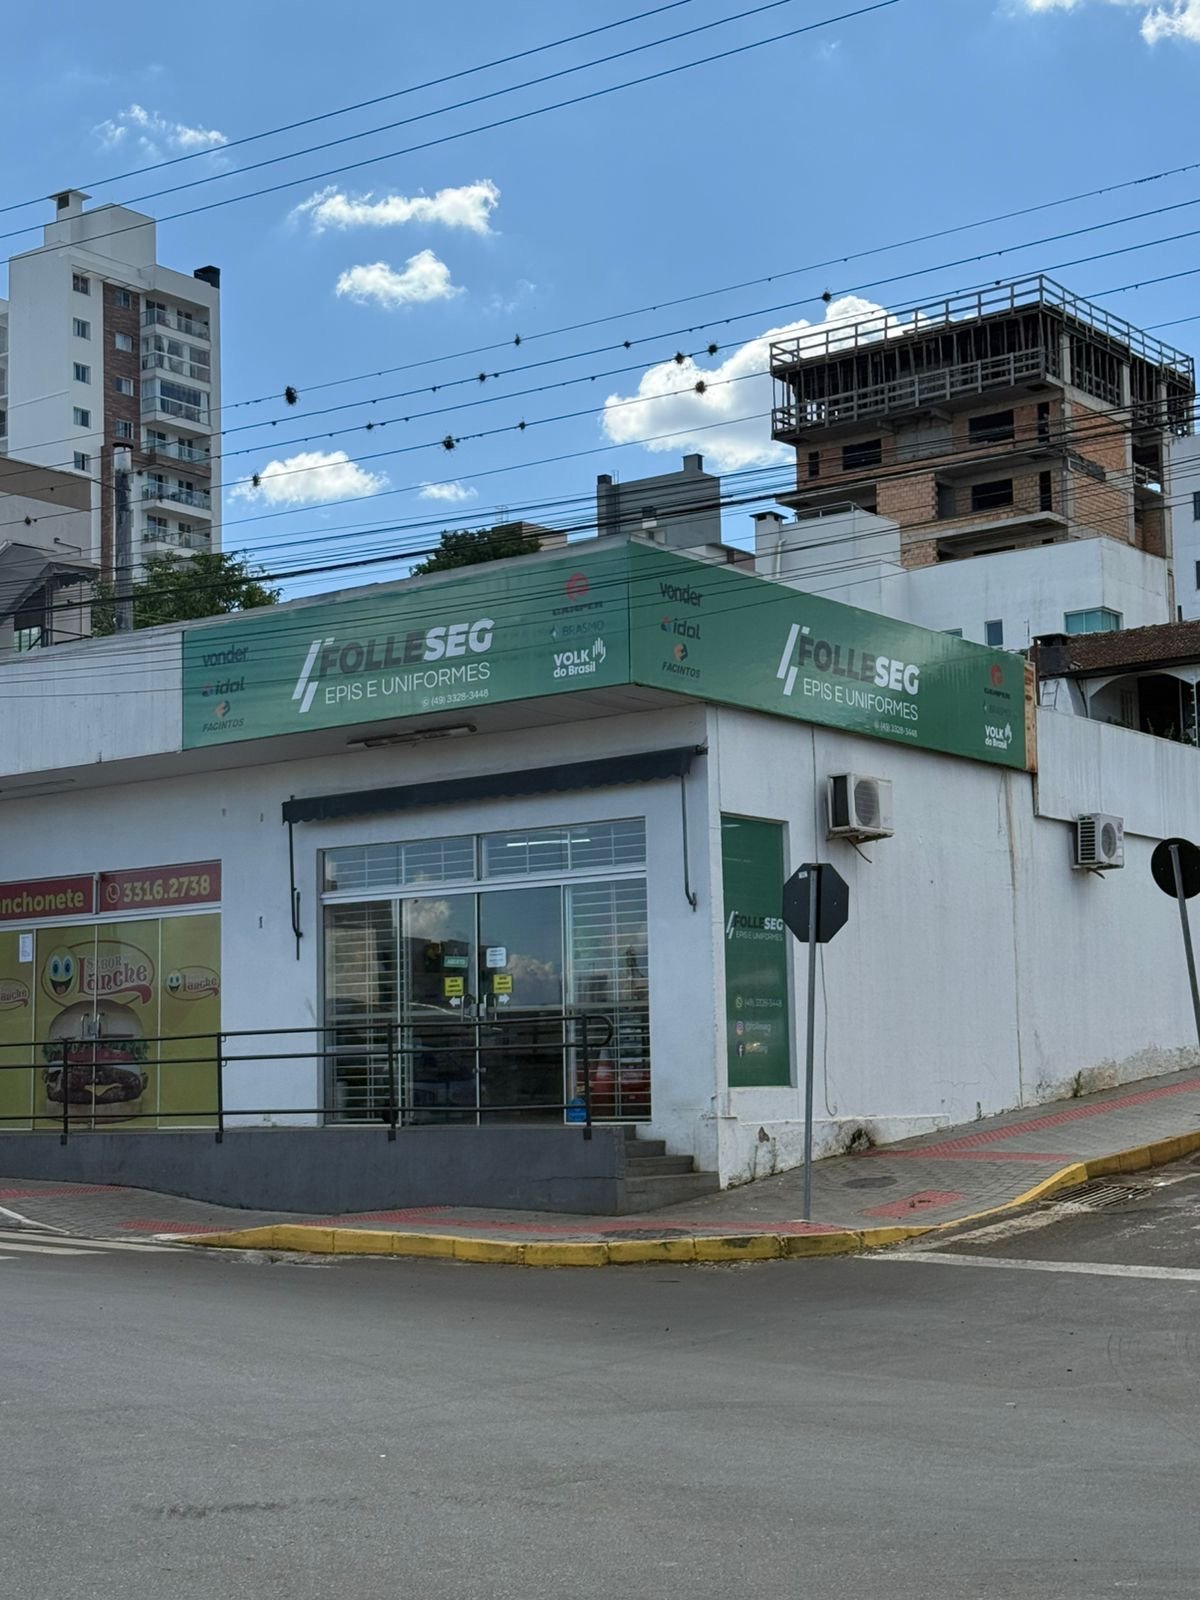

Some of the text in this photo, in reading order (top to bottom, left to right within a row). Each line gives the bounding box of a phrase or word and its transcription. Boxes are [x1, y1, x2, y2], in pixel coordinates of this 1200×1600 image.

[659, 582, 702, 607] vonder
[673, 618, 701, 639] idol
[319, 618, 495, 677] FOLLESEG
[553, 649, 589, 666] VOLK
[553, 664, 596, 678] do Brasil
[662, 661, 701, 679] FACINTOS
[797, 636, 920, 695] FOLLESEG
[215, 676, 245, 695] idol
[325, 662, 491, 704] EPIS E UNIFORMES
[431, 694, 446, 708] (49)
[803, 678, 919, 720] EPIS E UNIFORMES
[202, 718, 245, 732] FACINTOS
[985, 724, 1004, 740] VOLK
[123, 875, 210, 902] 3316.2738
[0, 889, 84, 914] nchonete
[87, 955, 123, 970] SBOR
